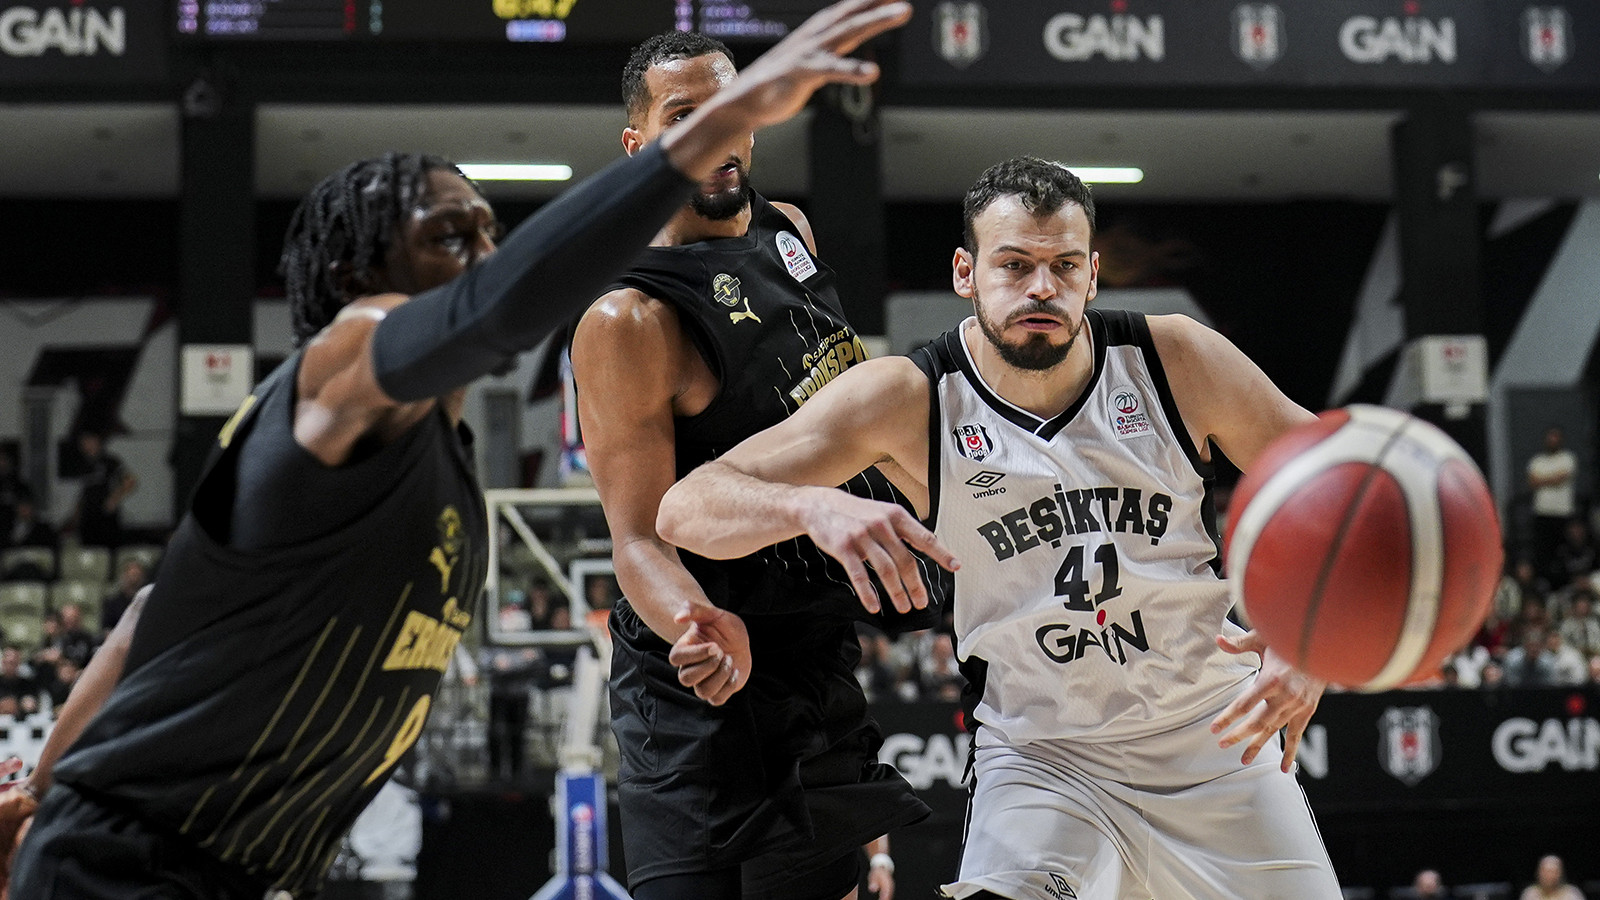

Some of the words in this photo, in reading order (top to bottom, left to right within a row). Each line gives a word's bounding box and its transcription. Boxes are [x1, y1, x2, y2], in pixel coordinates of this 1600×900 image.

[972, 487, 1007, 499] umbro
[976, 483, 1173, 562] BEŞİKTAŞ
[1054, 543, 1123, 612] 41
